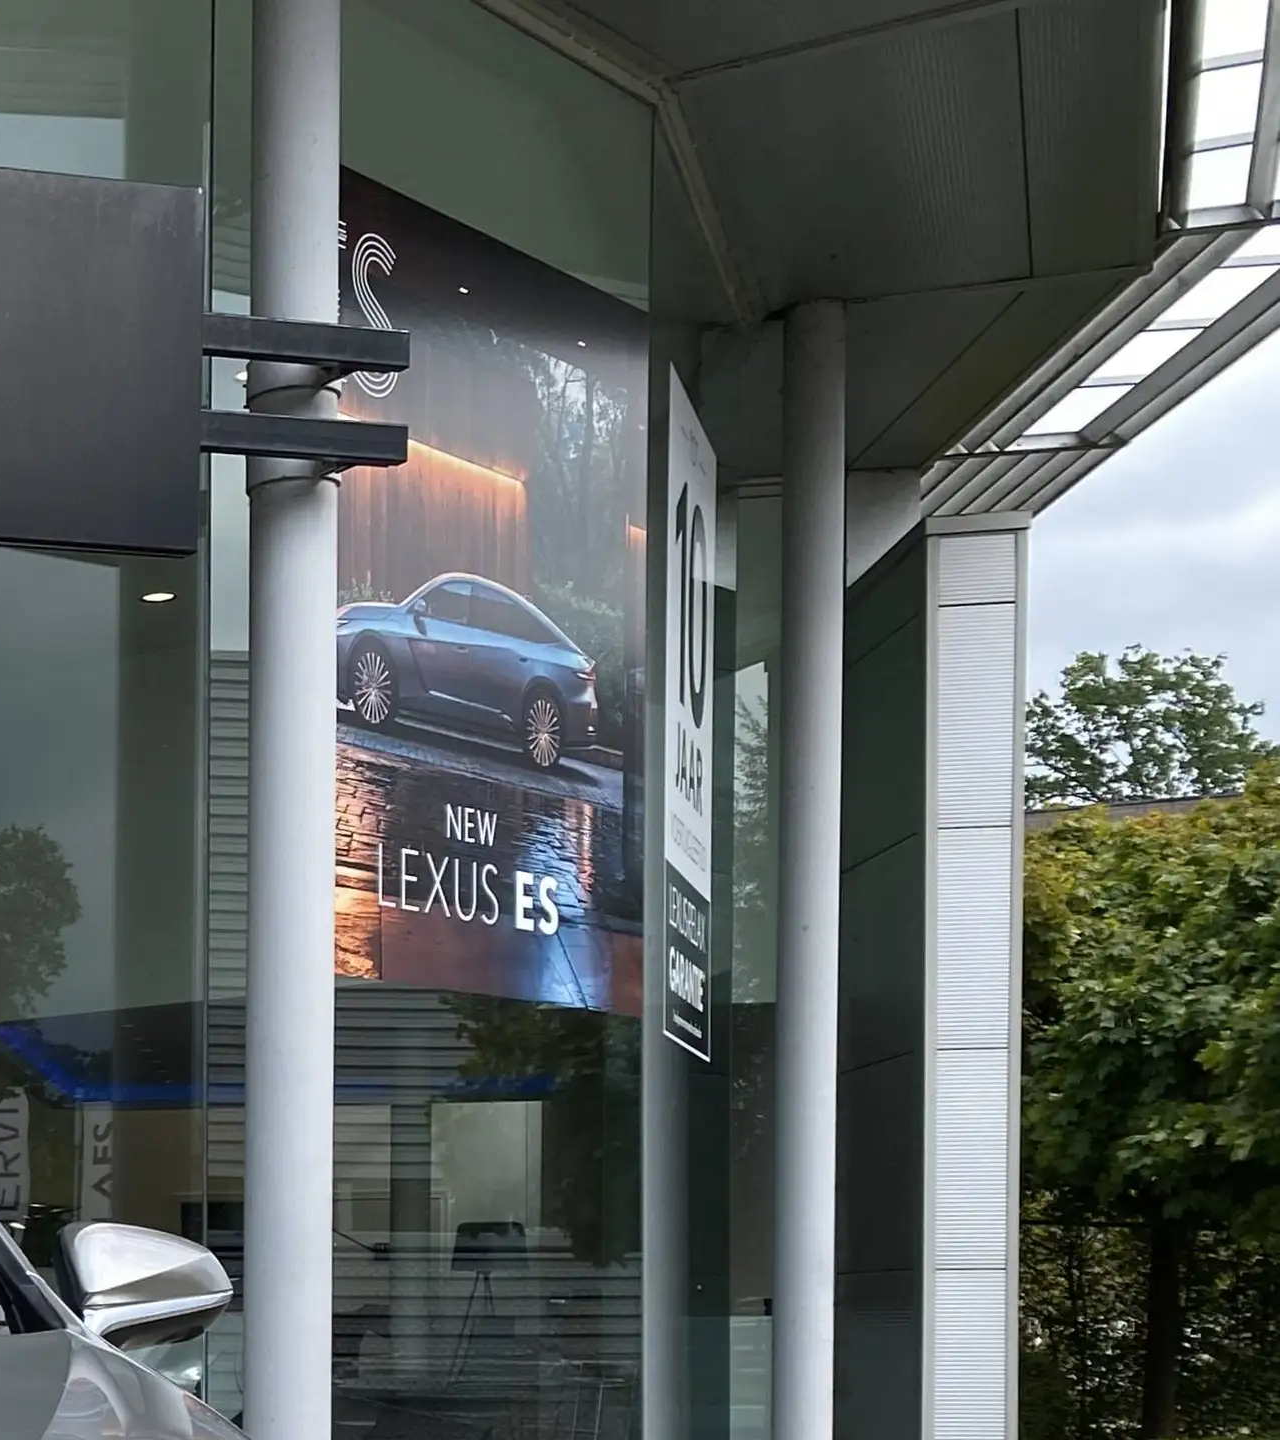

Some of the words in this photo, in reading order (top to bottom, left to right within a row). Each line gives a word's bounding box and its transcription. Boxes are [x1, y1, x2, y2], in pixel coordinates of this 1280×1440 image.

[675, 481, 707, 729] 10
[675, 721, 703, 817] JAAR
[446, 803, 498, 847] NEW
[378, 842, 500, 926] LEXUS
[515, 870, 560, 936] ES
